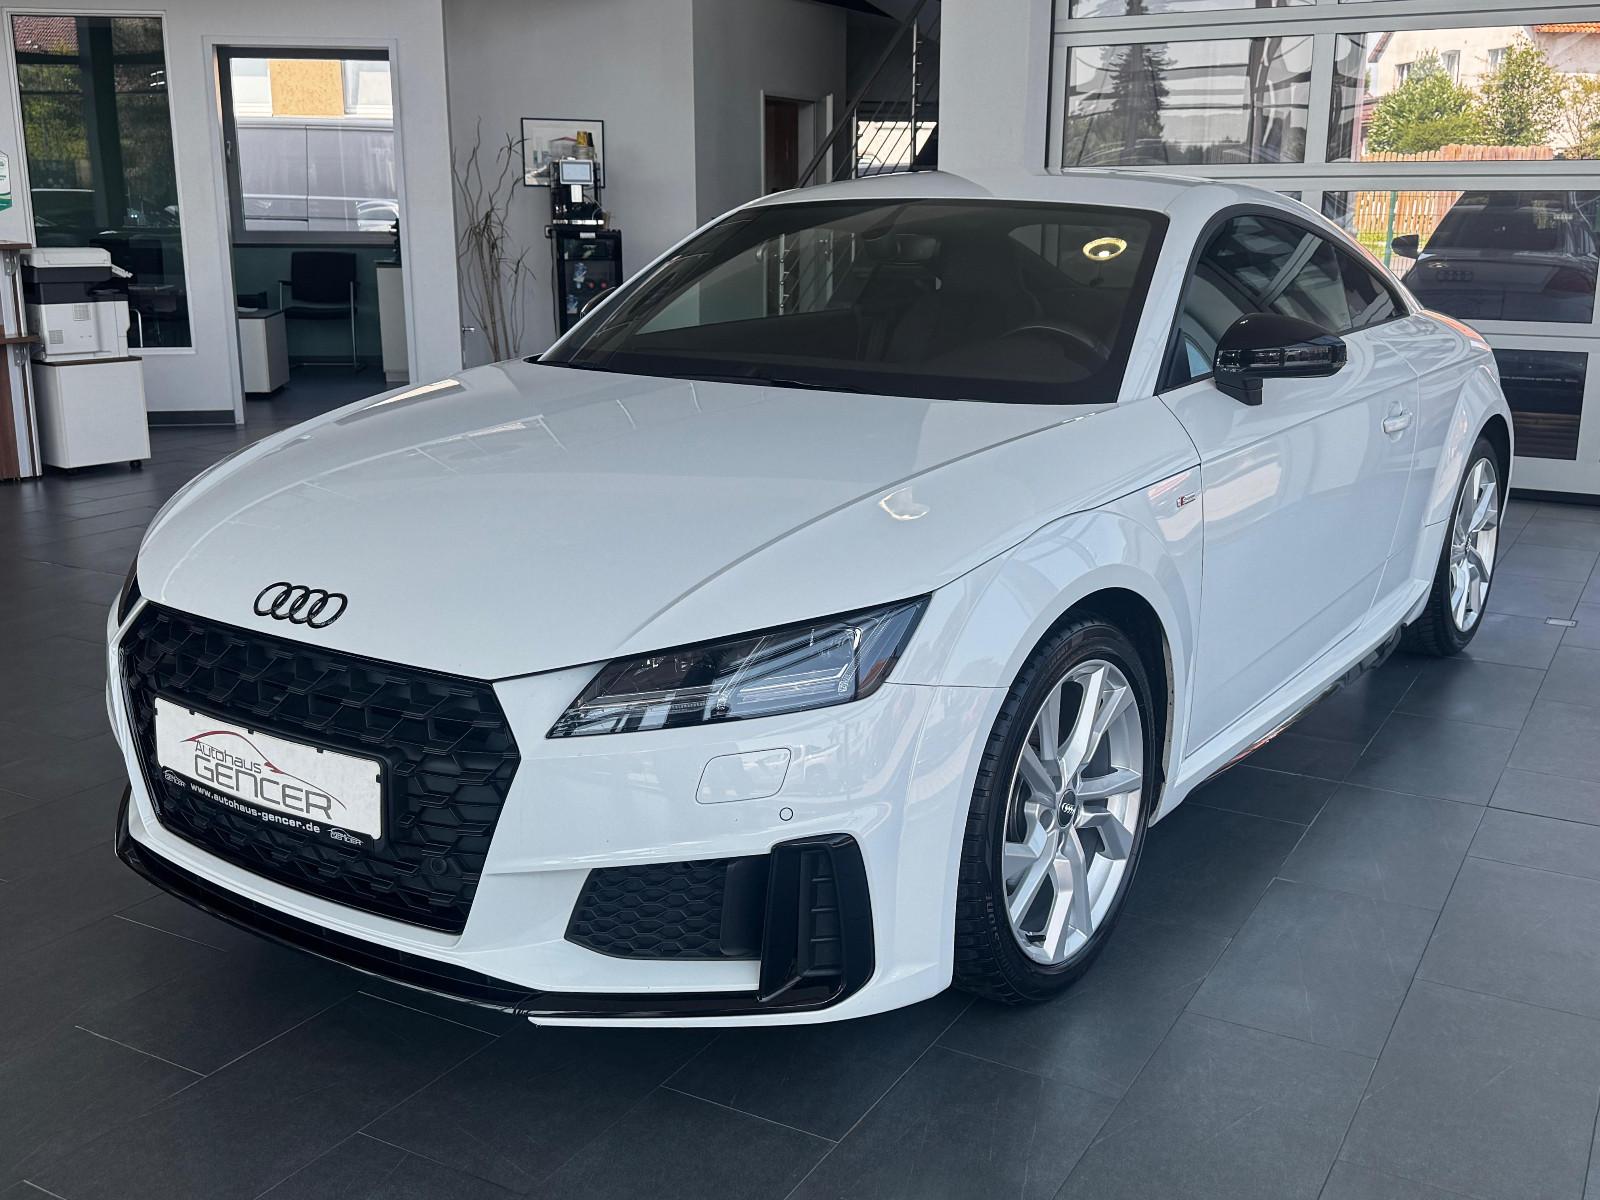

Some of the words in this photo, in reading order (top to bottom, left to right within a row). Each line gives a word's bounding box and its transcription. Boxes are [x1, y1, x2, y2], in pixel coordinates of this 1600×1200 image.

[195, 740, 261, 774] Autohaus
[190, 783, 321, 834] www.autohaus-gencer.de
[194, 754, 333, 820] GENCER
